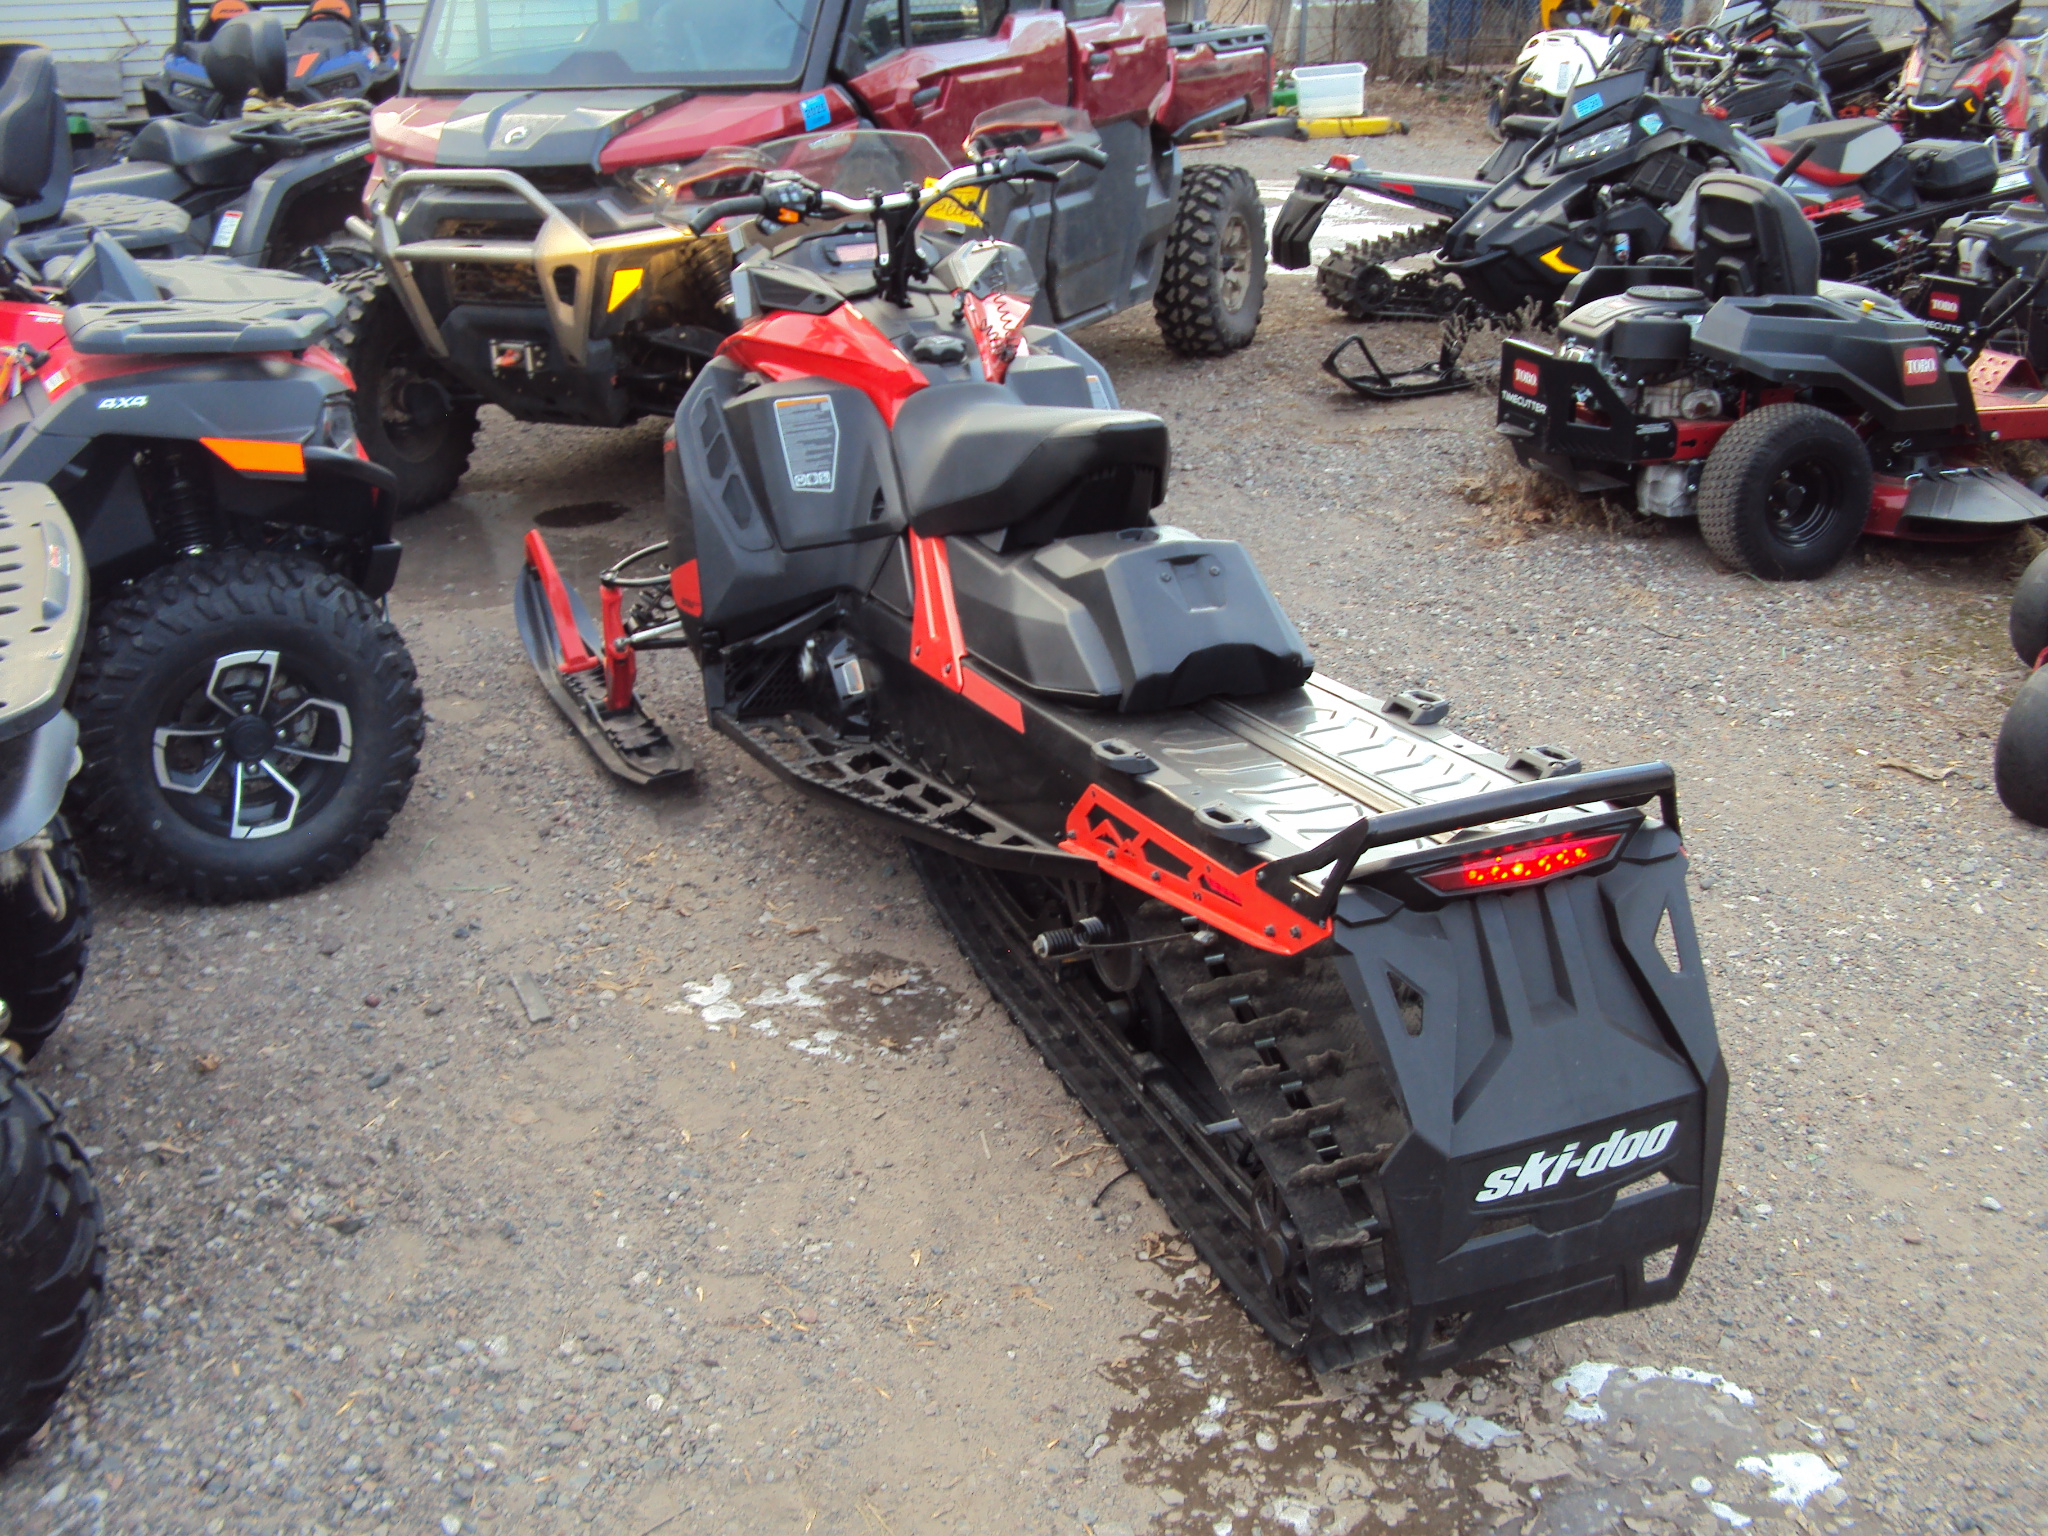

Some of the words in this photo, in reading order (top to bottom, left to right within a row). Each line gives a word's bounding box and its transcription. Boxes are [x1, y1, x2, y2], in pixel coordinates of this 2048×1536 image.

[1932, 299, 1958, 313] TORO
[1906, 357, 1936, 374] TORO
[1514, 367, 1538, 387] TORO
[1501, 389, 1548, 415] TIMECUTTER
[1475, 1119, 1679, 1203] ski-doo
